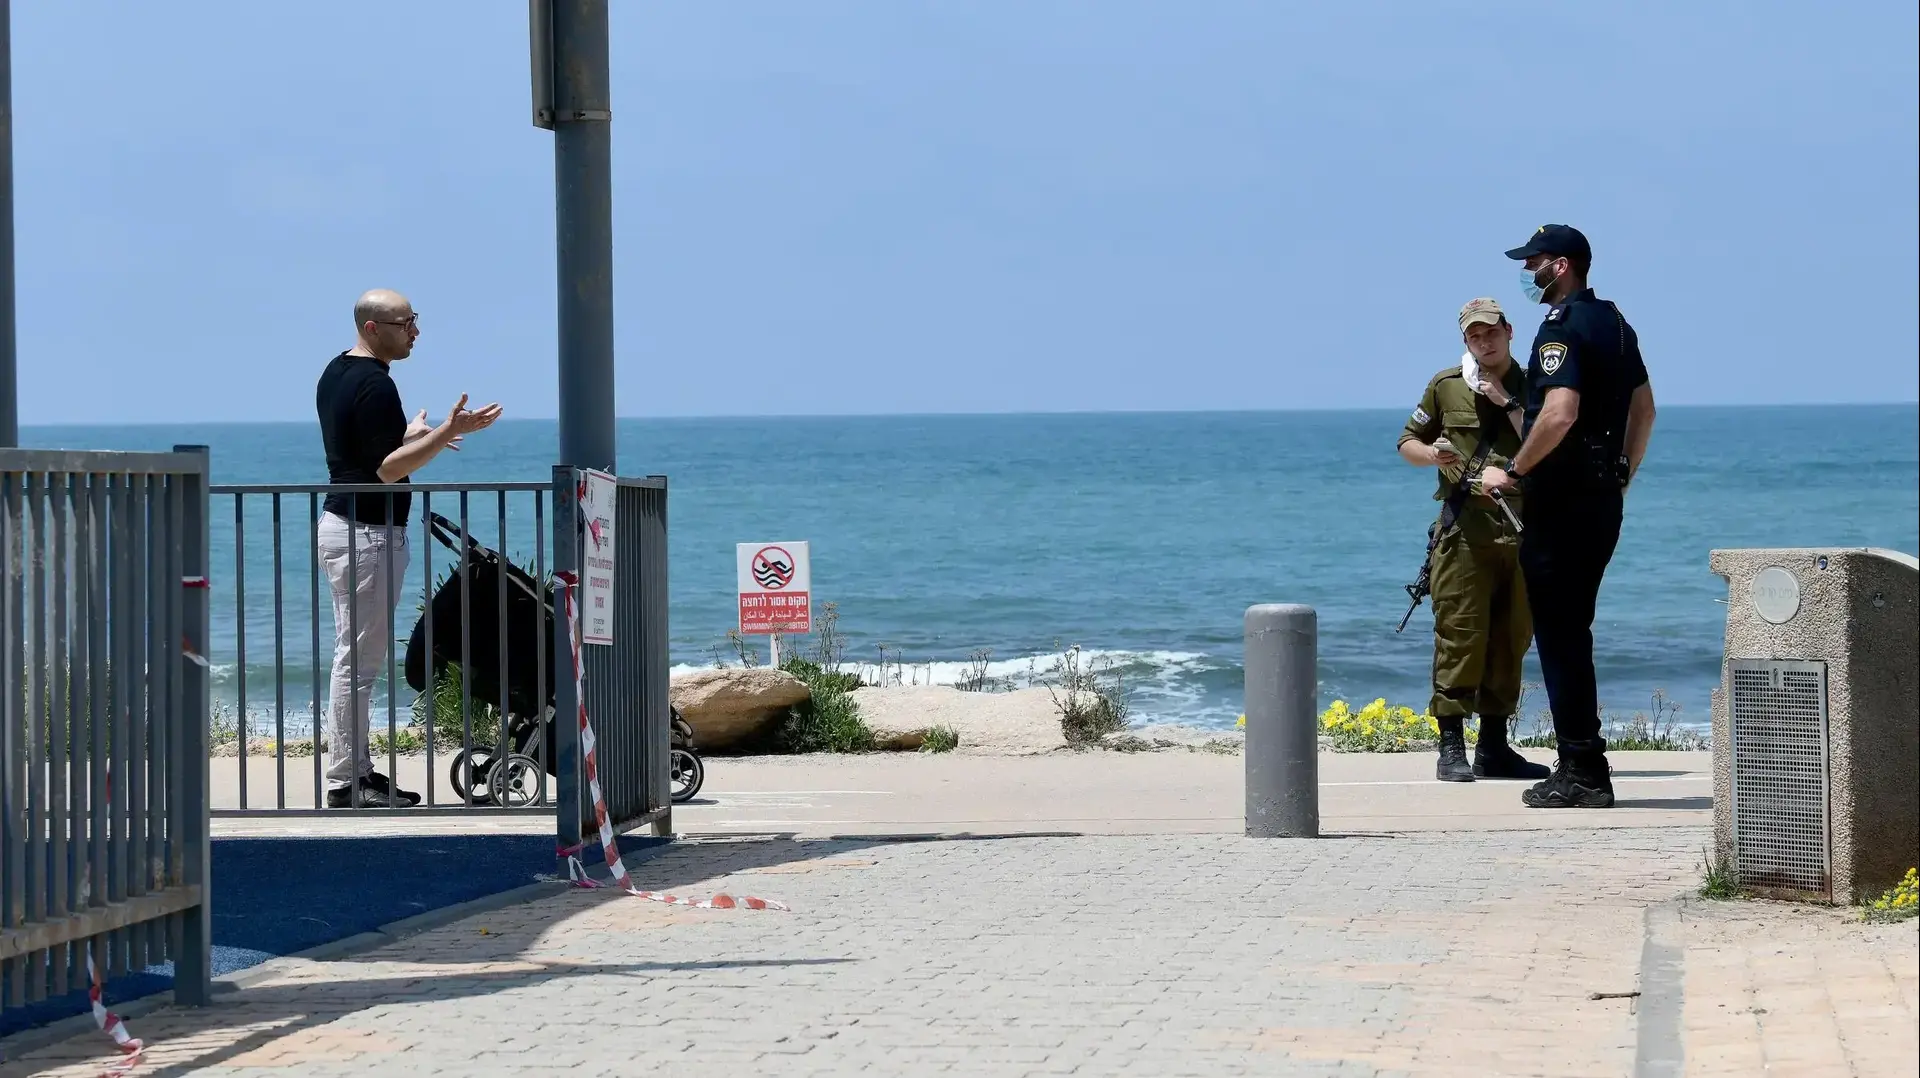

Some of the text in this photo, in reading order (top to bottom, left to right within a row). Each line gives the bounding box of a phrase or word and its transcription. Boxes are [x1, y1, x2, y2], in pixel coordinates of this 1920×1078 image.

[742, 594, 806, 608] מקום אסור לרחצה
[775, 621, 808, 629] IBITED
